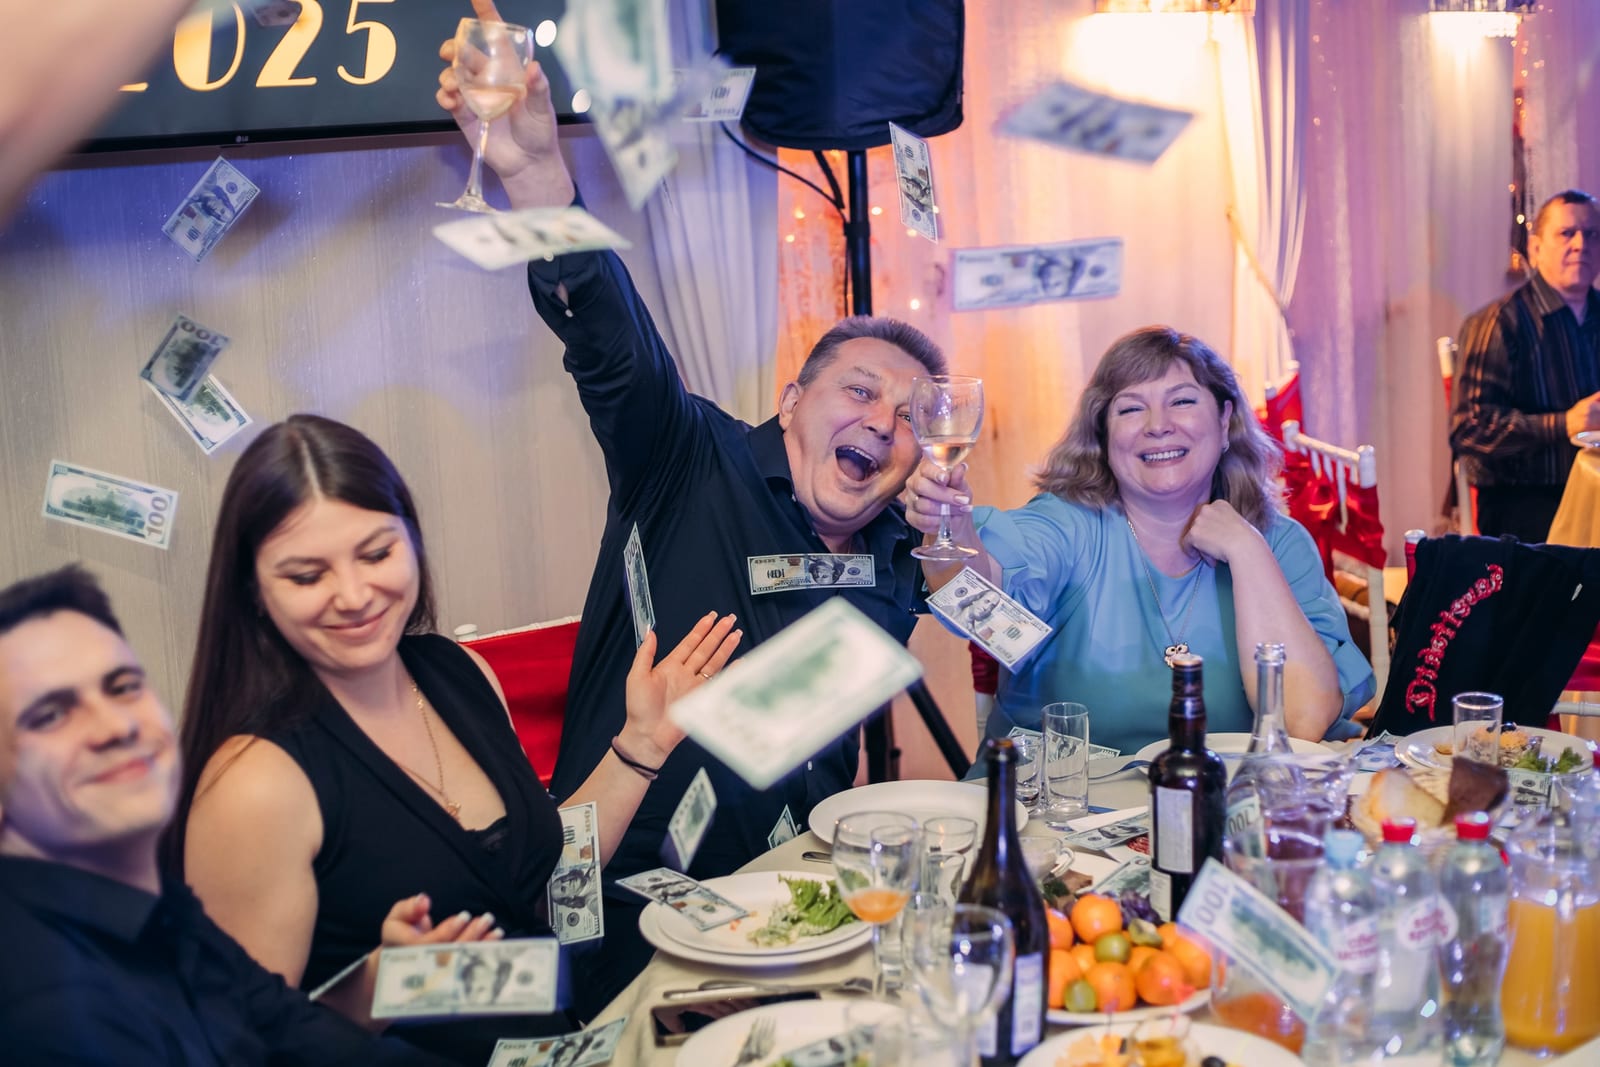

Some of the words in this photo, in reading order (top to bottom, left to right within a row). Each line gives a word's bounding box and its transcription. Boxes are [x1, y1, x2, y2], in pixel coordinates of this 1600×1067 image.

[118, 0, 397, 91] 025
[145, 495, 169, 536] 100
[1195, 879, 1231, 925] 100
